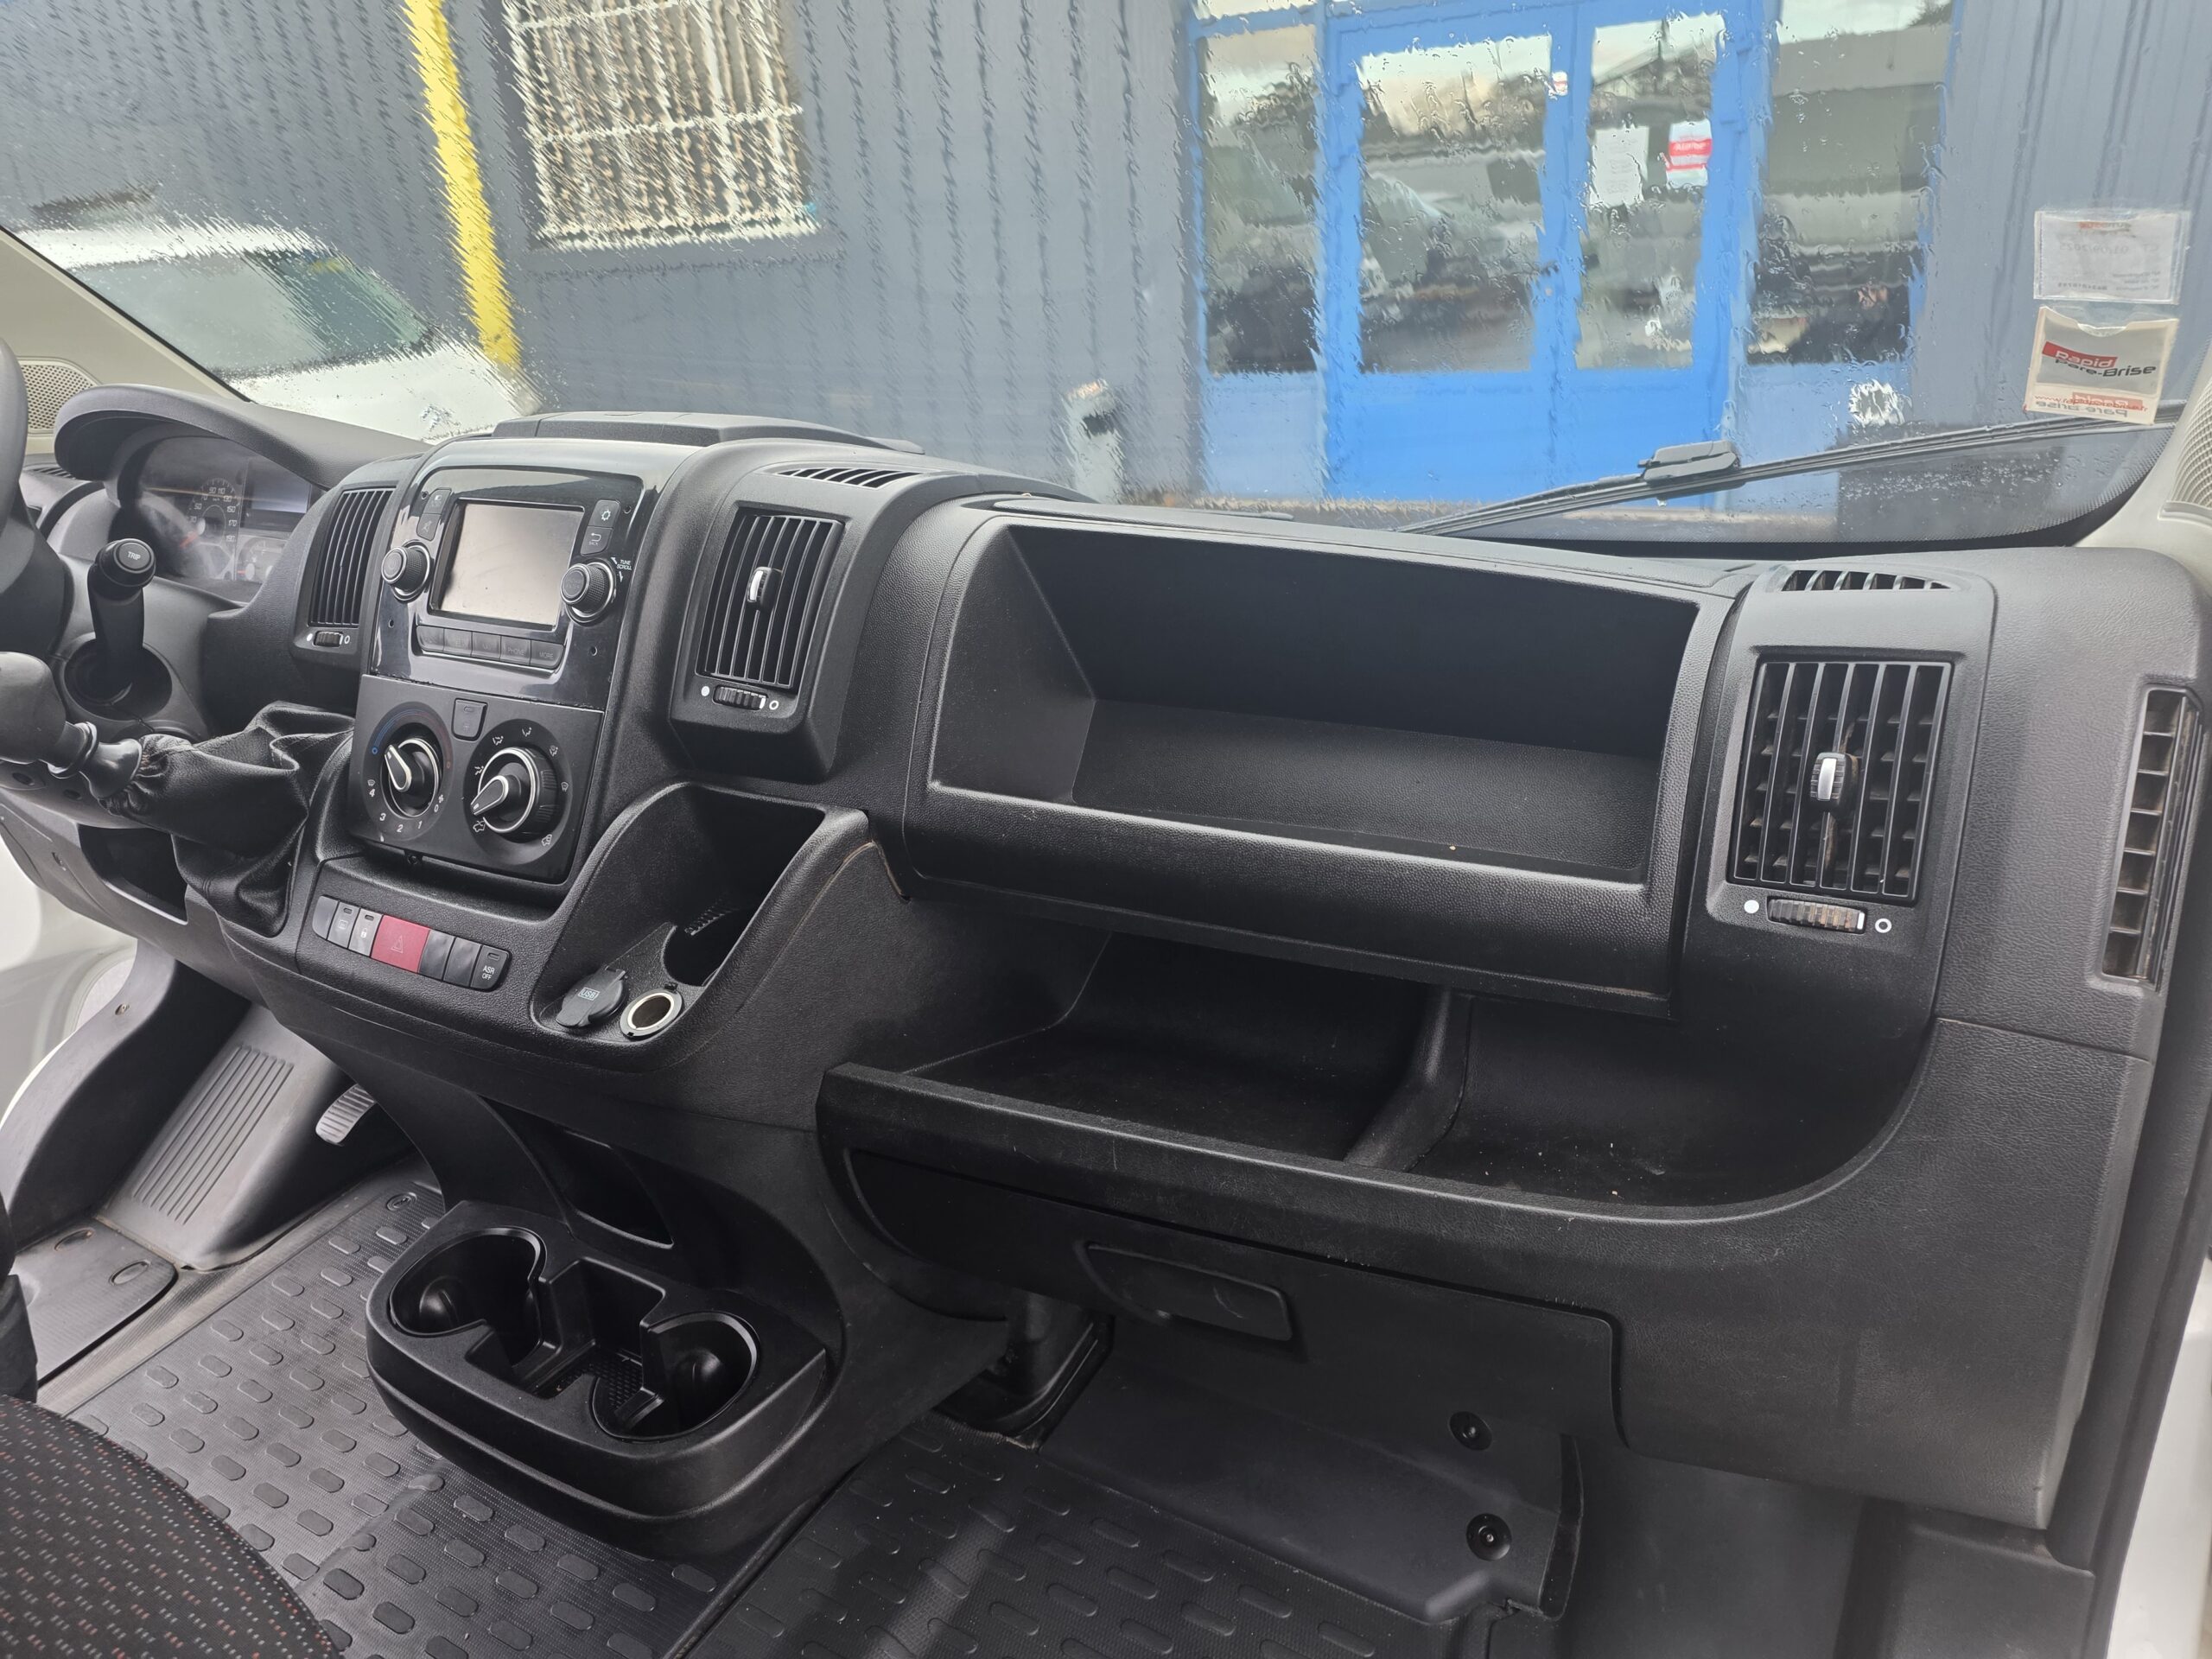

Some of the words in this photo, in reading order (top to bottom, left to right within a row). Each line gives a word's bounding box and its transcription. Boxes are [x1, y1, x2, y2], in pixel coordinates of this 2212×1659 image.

[2056, 350, 2113, 367] Rapid
[128, 551, 141, 561] TRIP
[369, 788, 376, 798] 4
[379, 812, 386, 822] 3
[397, 823, 404, 833] 2
[417, 820, 423, 830] 1
[483, 964, 495, 976] ASR
[481, 972, 493, 981] OFF
[581, 988, 596, 999] USB
